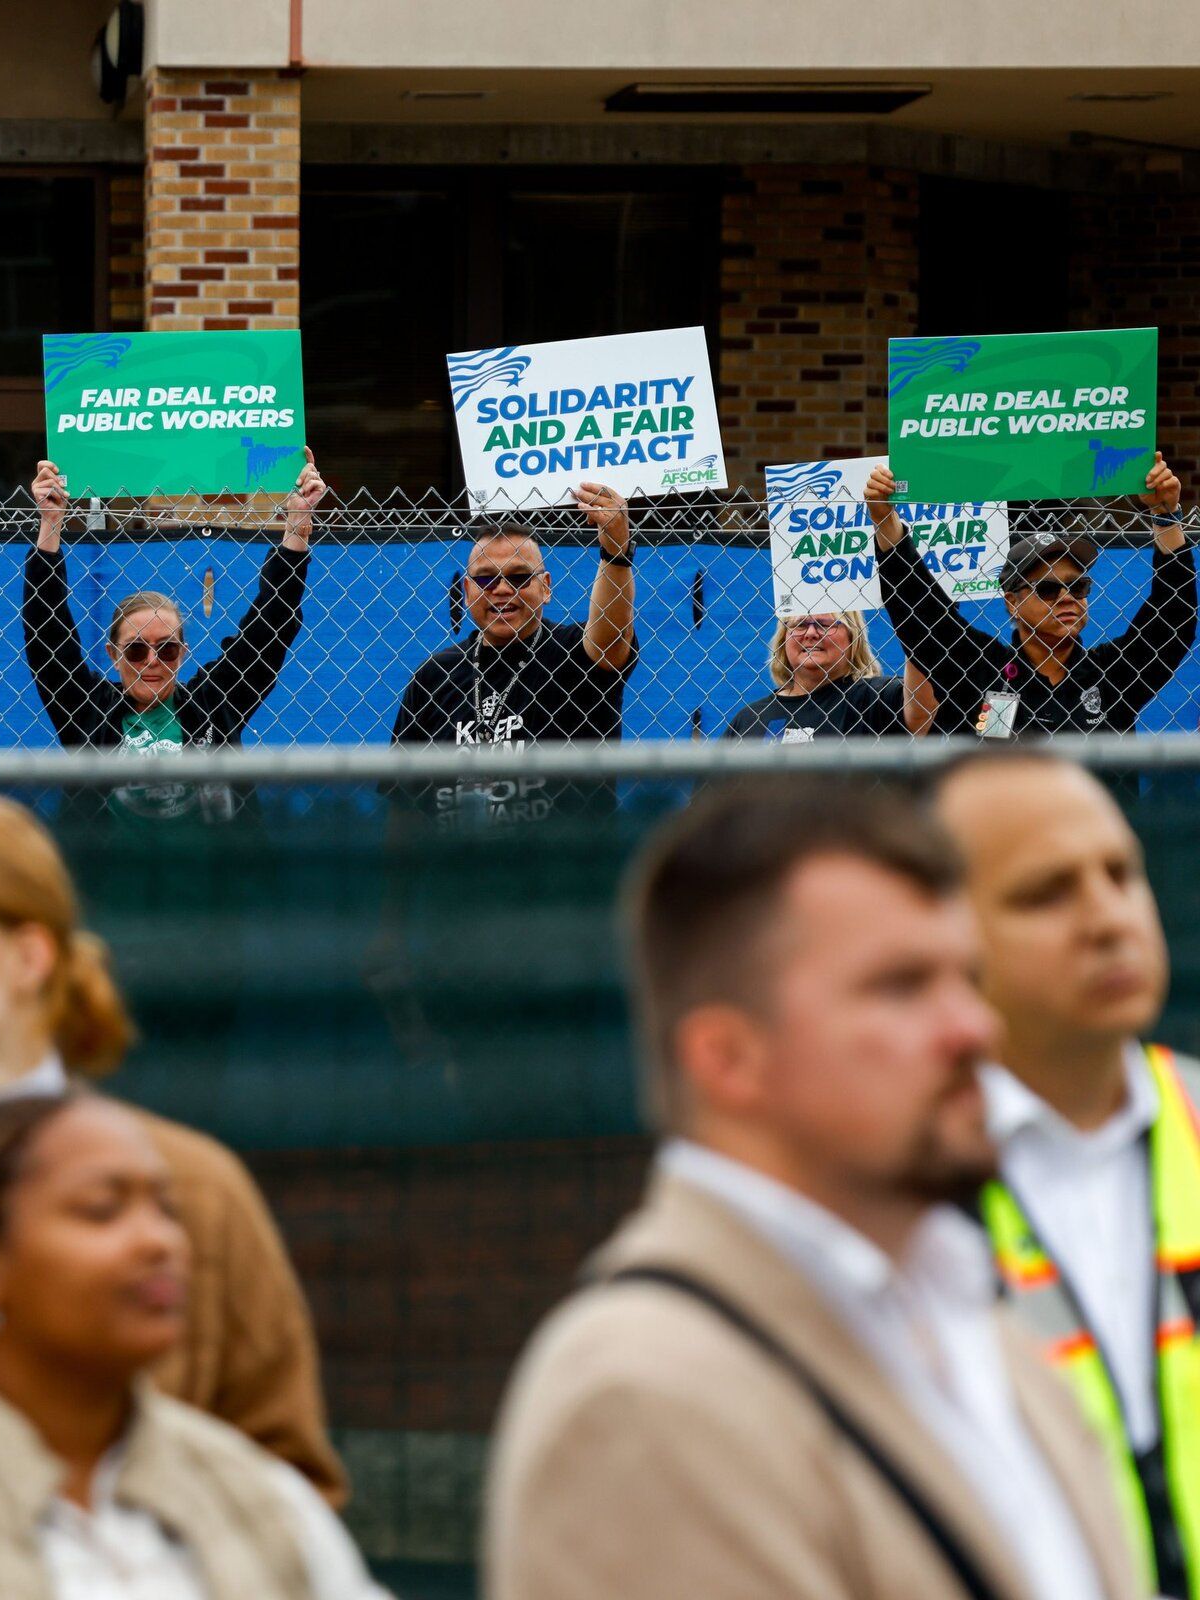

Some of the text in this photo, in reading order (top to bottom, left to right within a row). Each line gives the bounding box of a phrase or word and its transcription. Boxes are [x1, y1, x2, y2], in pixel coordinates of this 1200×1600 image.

[80, 385, 276, 408] FAIR DEAL FOR
[476, 376, 695, 424] SOLIDARITY
[924, 386, 1129, 413] FAIR DEAL FOR
[57, 408, 294, 433] PUBLIC WORKERS
[483, 405, 694, 452] AND A FAIR
[899, 409, 1146, 438] PUBLIC WORKERS
[495, 434, 694, 478] CONTRACT
[661, 469, 718, 485] AFSCME
[791, 519, 988, 559] AND FAIR
[801, 546, 986, 584] CONACT
[952, 580, 1001, 593] AFSCM
[437, 798, 549, 828] STARD
